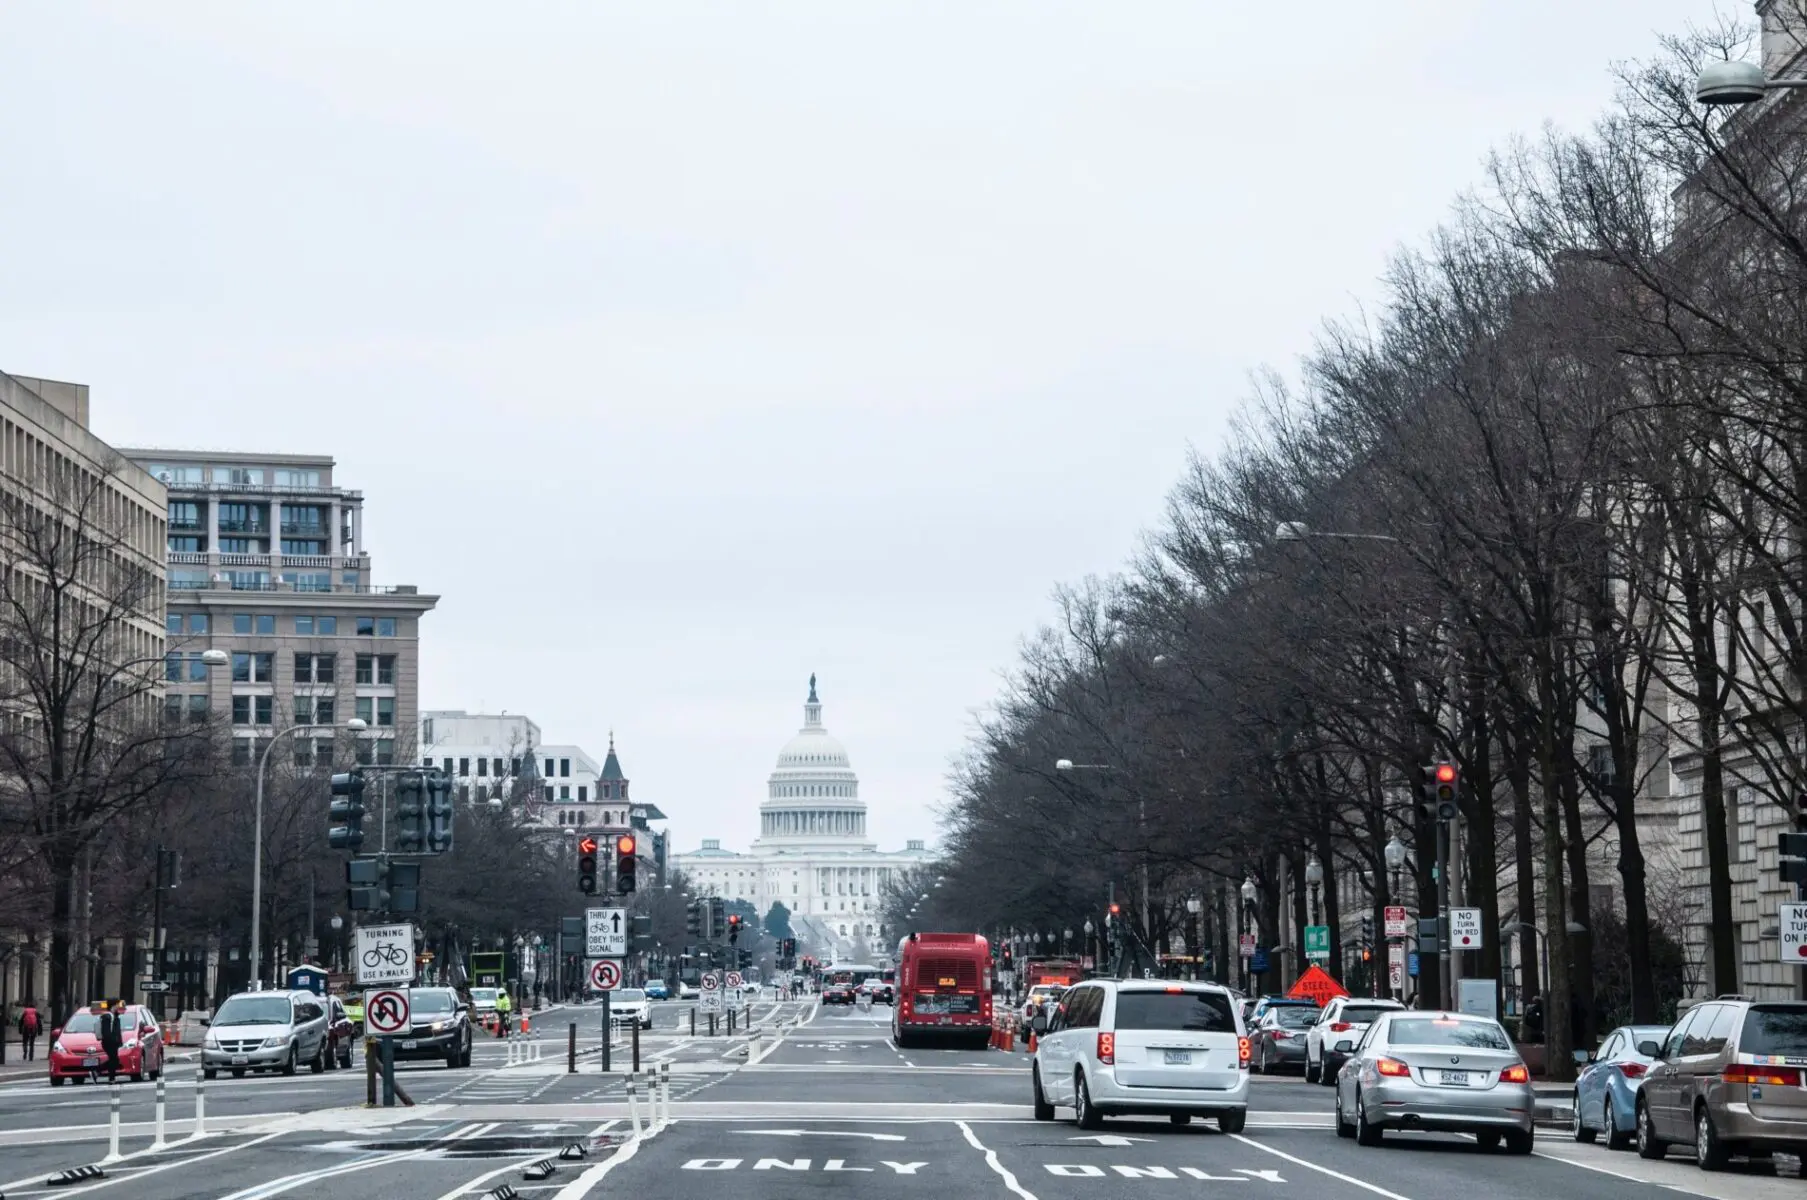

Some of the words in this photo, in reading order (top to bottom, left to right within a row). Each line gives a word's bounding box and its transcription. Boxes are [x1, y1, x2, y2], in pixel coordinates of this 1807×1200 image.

[590, 911, 607, 919] THRU
[1458, 912, 1472, 920] NO
[365, 929, 404, 939] TURNING
[1784, 933, 1798, 943] ON
[589, 935, 607, 944] OBEY
[610, 935, 625, 944] THIS
[589, 944, 613, 952] SIGNAL
[363, 970, 377, 979] USE
[380, 968, 409, 977] X-WALKS
[1303, 981, 1330, 990] STEEL
[680, 1159, 930, 1174] ONLY
[1043, 1164, 1288, 1183] ONLY
